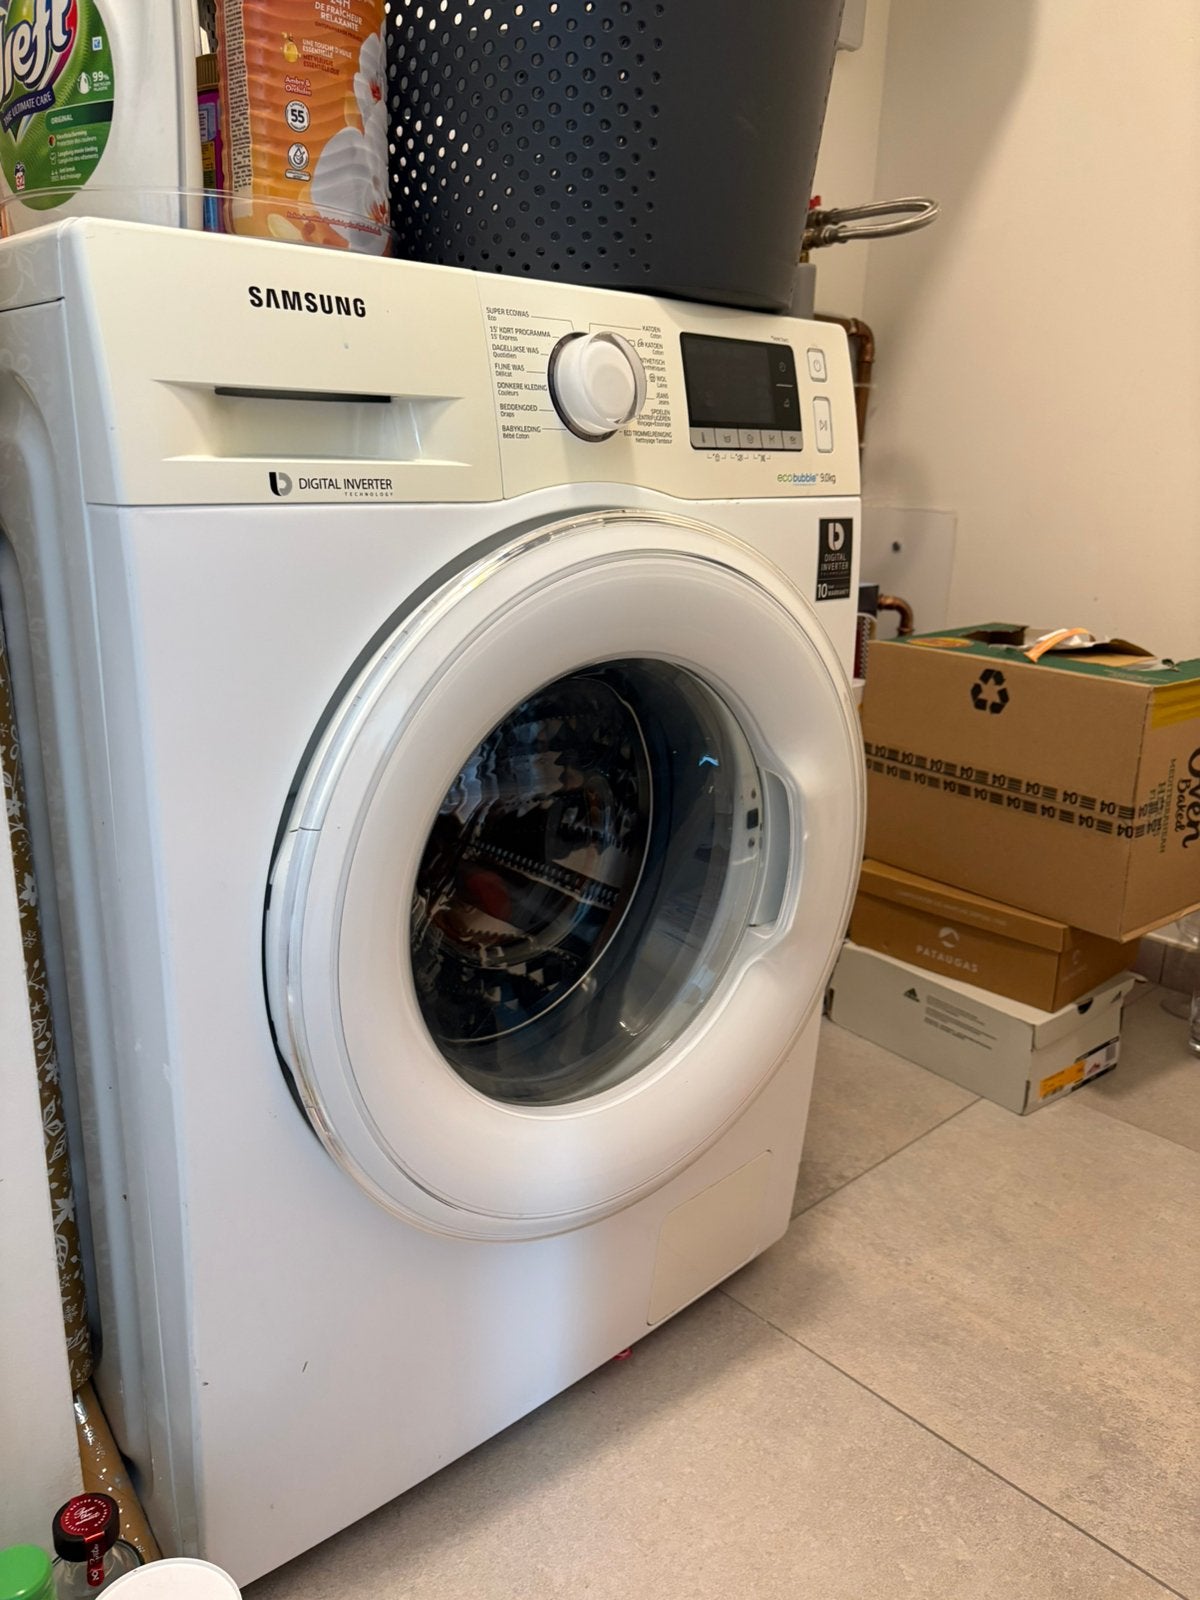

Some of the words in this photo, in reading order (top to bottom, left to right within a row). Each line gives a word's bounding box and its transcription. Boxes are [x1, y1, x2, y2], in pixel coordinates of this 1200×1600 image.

[314, 2, 325, 10] DE
[320, 12, 359, 32] RELAXANTE
[0, 0, 68, 97] reft
[12, 99, 35, 119] ULTIMATE
[35, 91, 52, 106] CARE
[291, 109, 305, 124] 55
[248, 286, 366, 318] SAMSUNG
[486, 307, 505, 315] SUPER
[515, 328, 551, 338] PROGRAMMA
[492, 344, 525, 353] DAGELIJKSE
[500, 403, 538, 411] BEDDENGOED
[502, 425, 541, 433] BABYKLEDING
[298, 478, 341, 490] DIGITAL
[344, 478, 392, 490] INVERTER
[824, 553, 846, 562] DIGITAL
[821, 561, 849, 570] INVERTER
[818, 583, 828, 598] 10
[1041, 805, 1055, 818] 04
[1174, 778, 1191, 832] Baked
[1078, 814, 1094, 828] 04
[1117, 824, 1133, 838] 04
[916, 944, 978, 973] PATAUGAS
